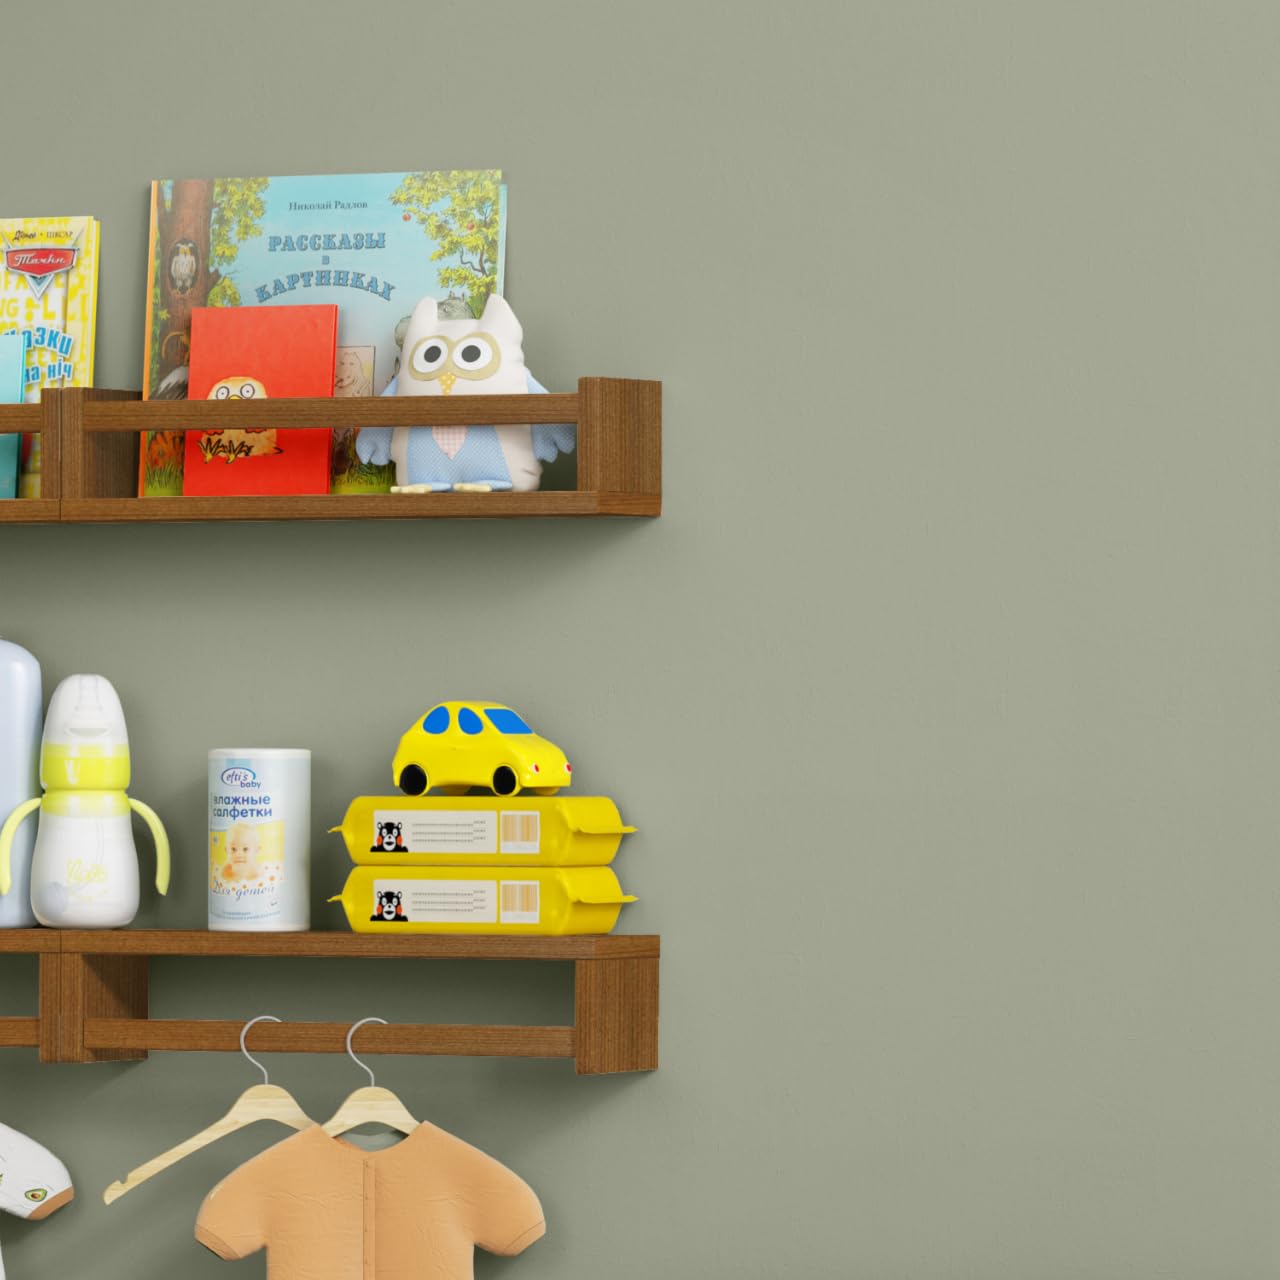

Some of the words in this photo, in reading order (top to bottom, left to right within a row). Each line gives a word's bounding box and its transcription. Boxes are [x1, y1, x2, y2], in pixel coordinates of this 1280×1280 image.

[289, 201, 332, 211] Николай
[334, 200, 368, 210] Радлов
[268, 233, 386, 252] РАССКАЗЫ
[14, 252, 66, 266] Тачки
[254, 269, 397, 303] КАРТИНКАХ
[47, 357, 72, 379] ніч
[240, 780, 261, 789] baby
[213, 795, 271, 806] влажные
[213, 805, 273, 821] салфетки
